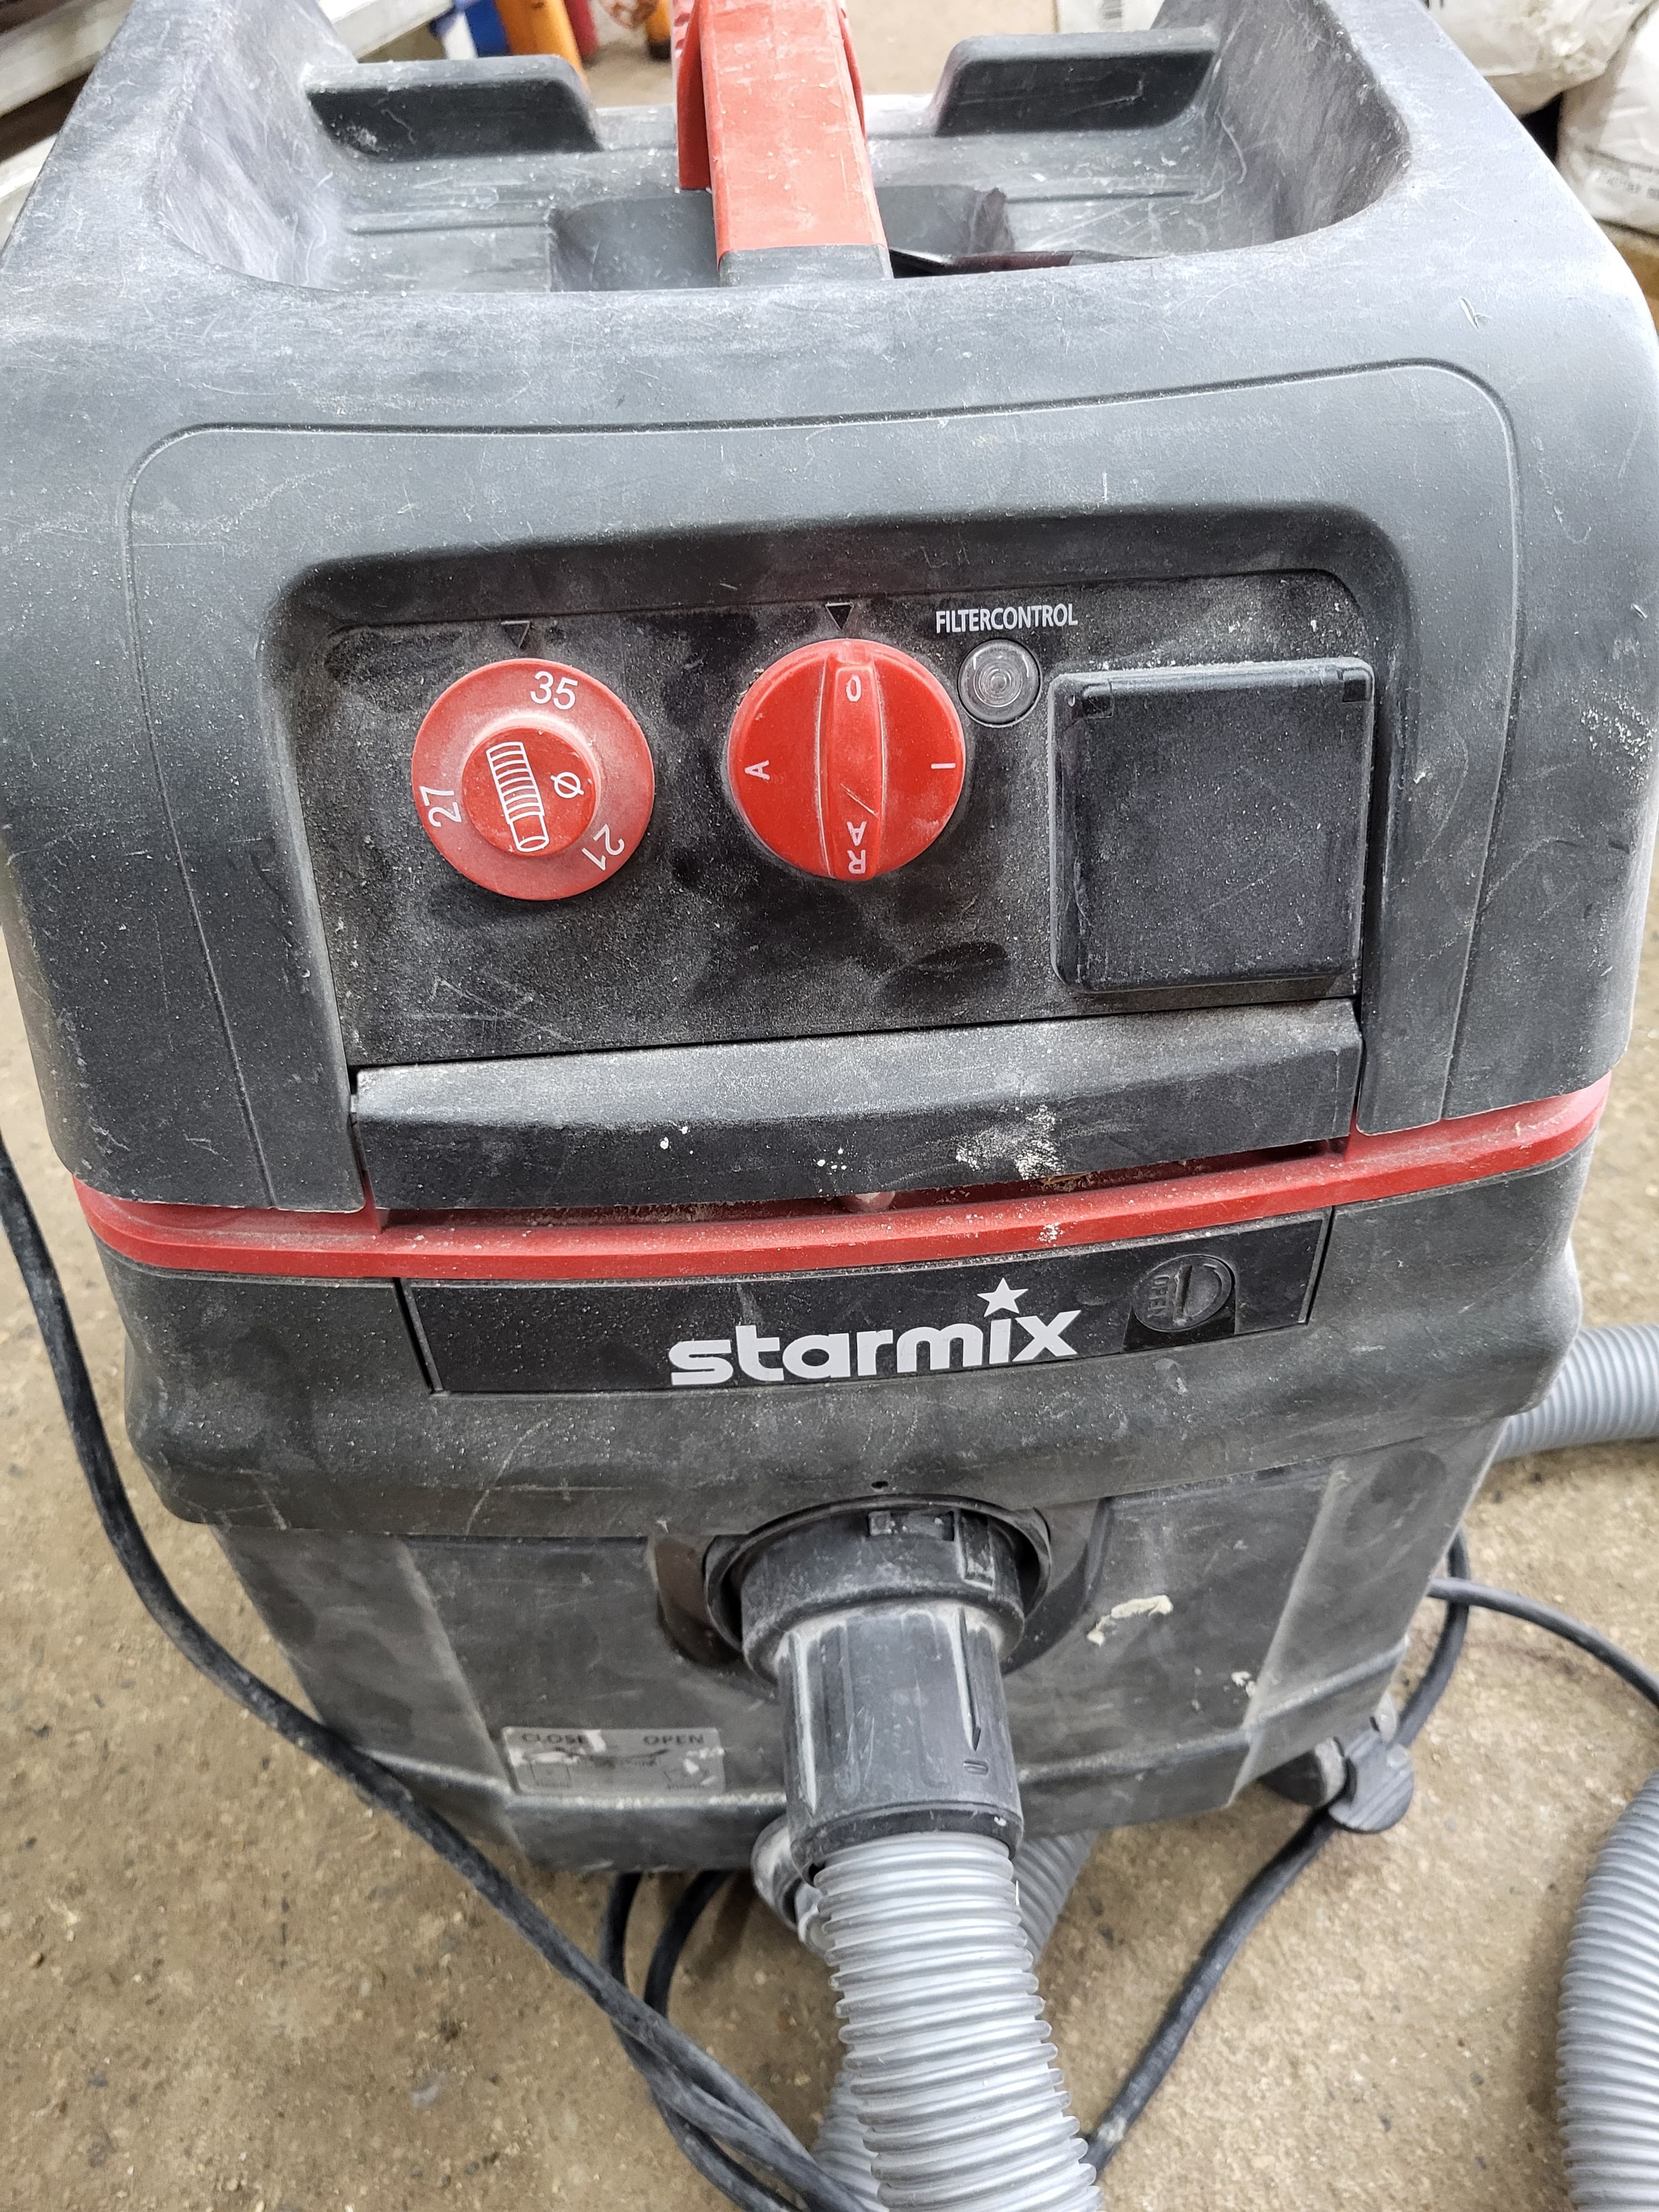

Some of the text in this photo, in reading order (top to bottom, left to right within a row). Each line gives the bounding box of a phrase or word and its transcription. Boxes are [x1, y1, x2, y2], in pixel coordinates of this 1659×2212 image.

[936, 603, 1078, 634] FILTERCONTROL
[530, 670, 578, 710] 35
[744, 760, 770, 780] A
[419, 785, 462, 828] 27
[581, 823, 625, 872] 21
[669, 1277, 1082, 1386] starmix
[643, 1734, 705, 1745] OPEN
